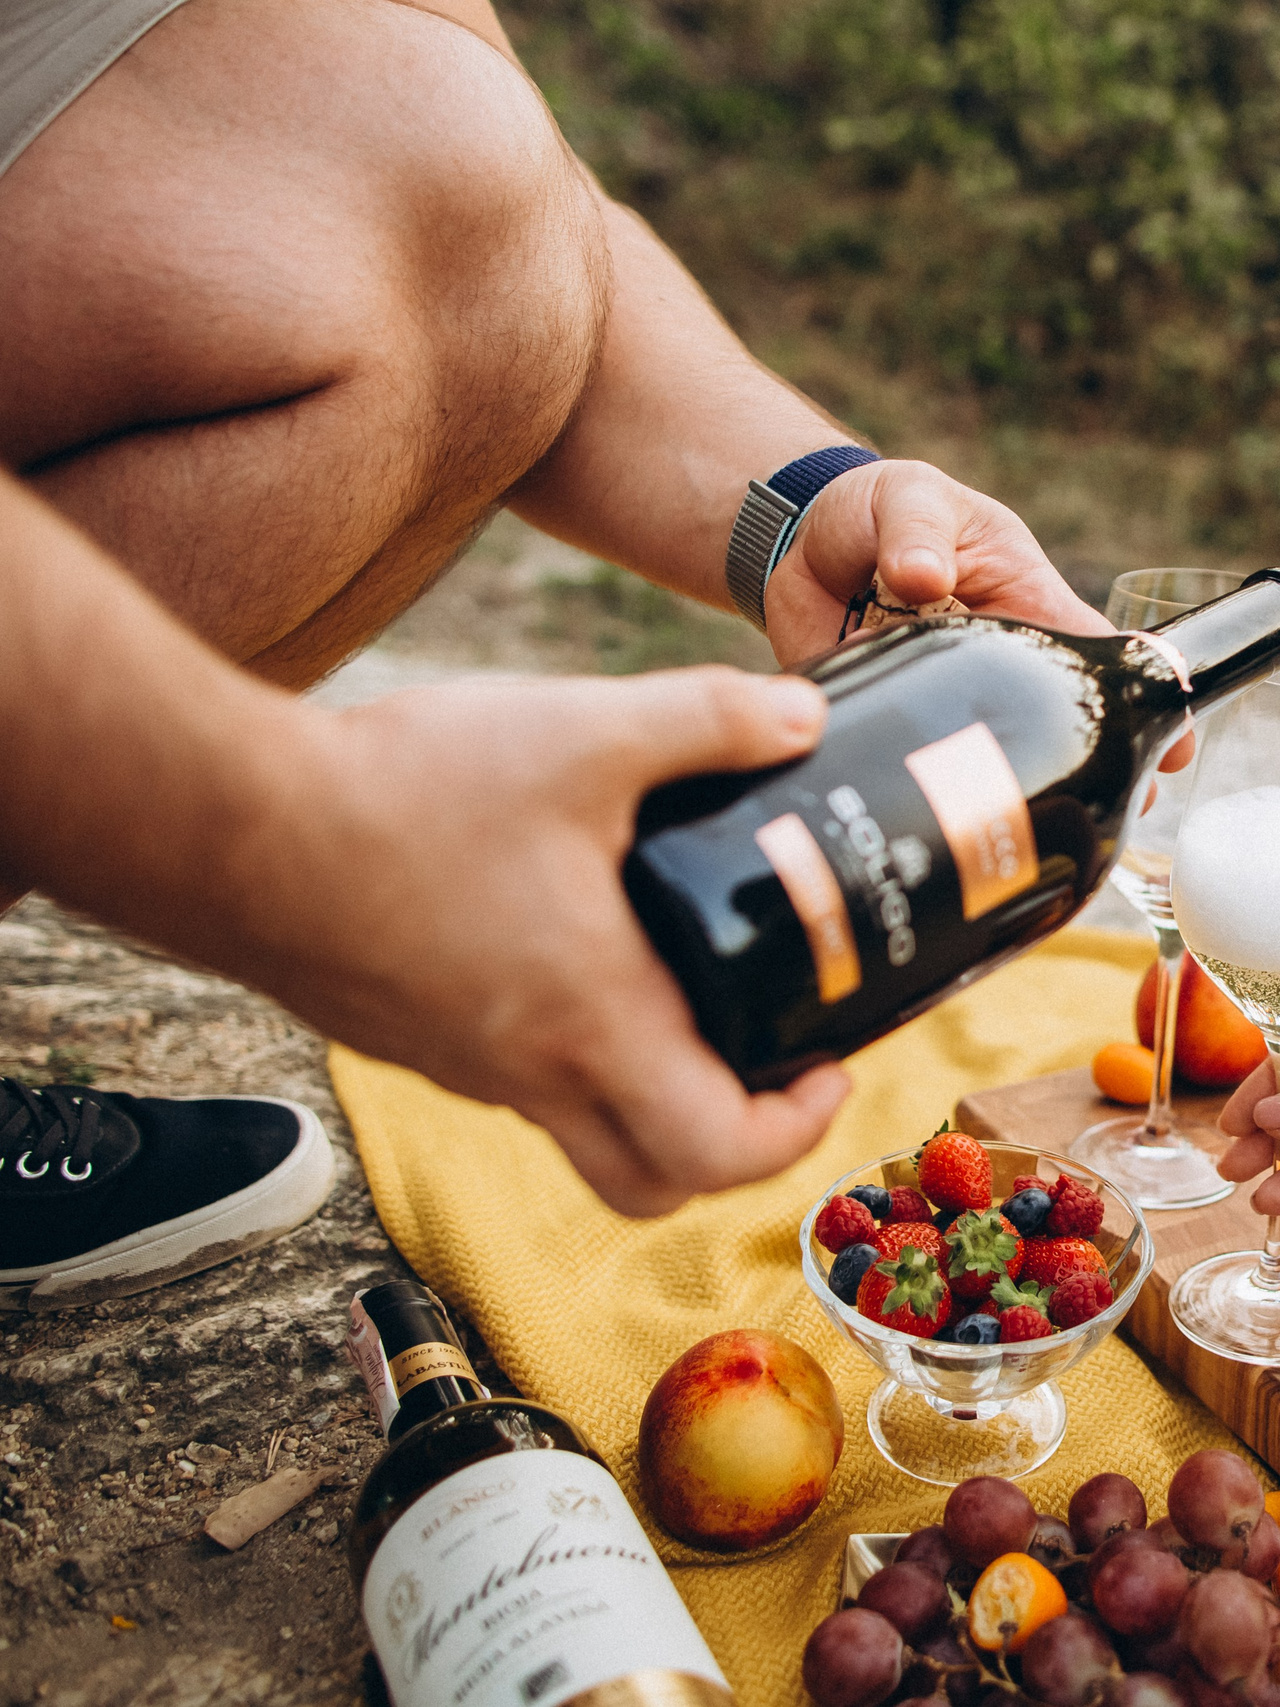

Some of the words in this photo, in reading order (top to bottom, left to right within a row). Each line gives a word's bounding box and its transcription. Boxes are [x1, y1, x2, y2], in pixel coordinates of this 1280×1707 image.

[401, 1347, 434, 1364] SINCE
[421, 1479, 517, 1542] BLANCO
[403, 1522, 649, 1684] Montebuena
